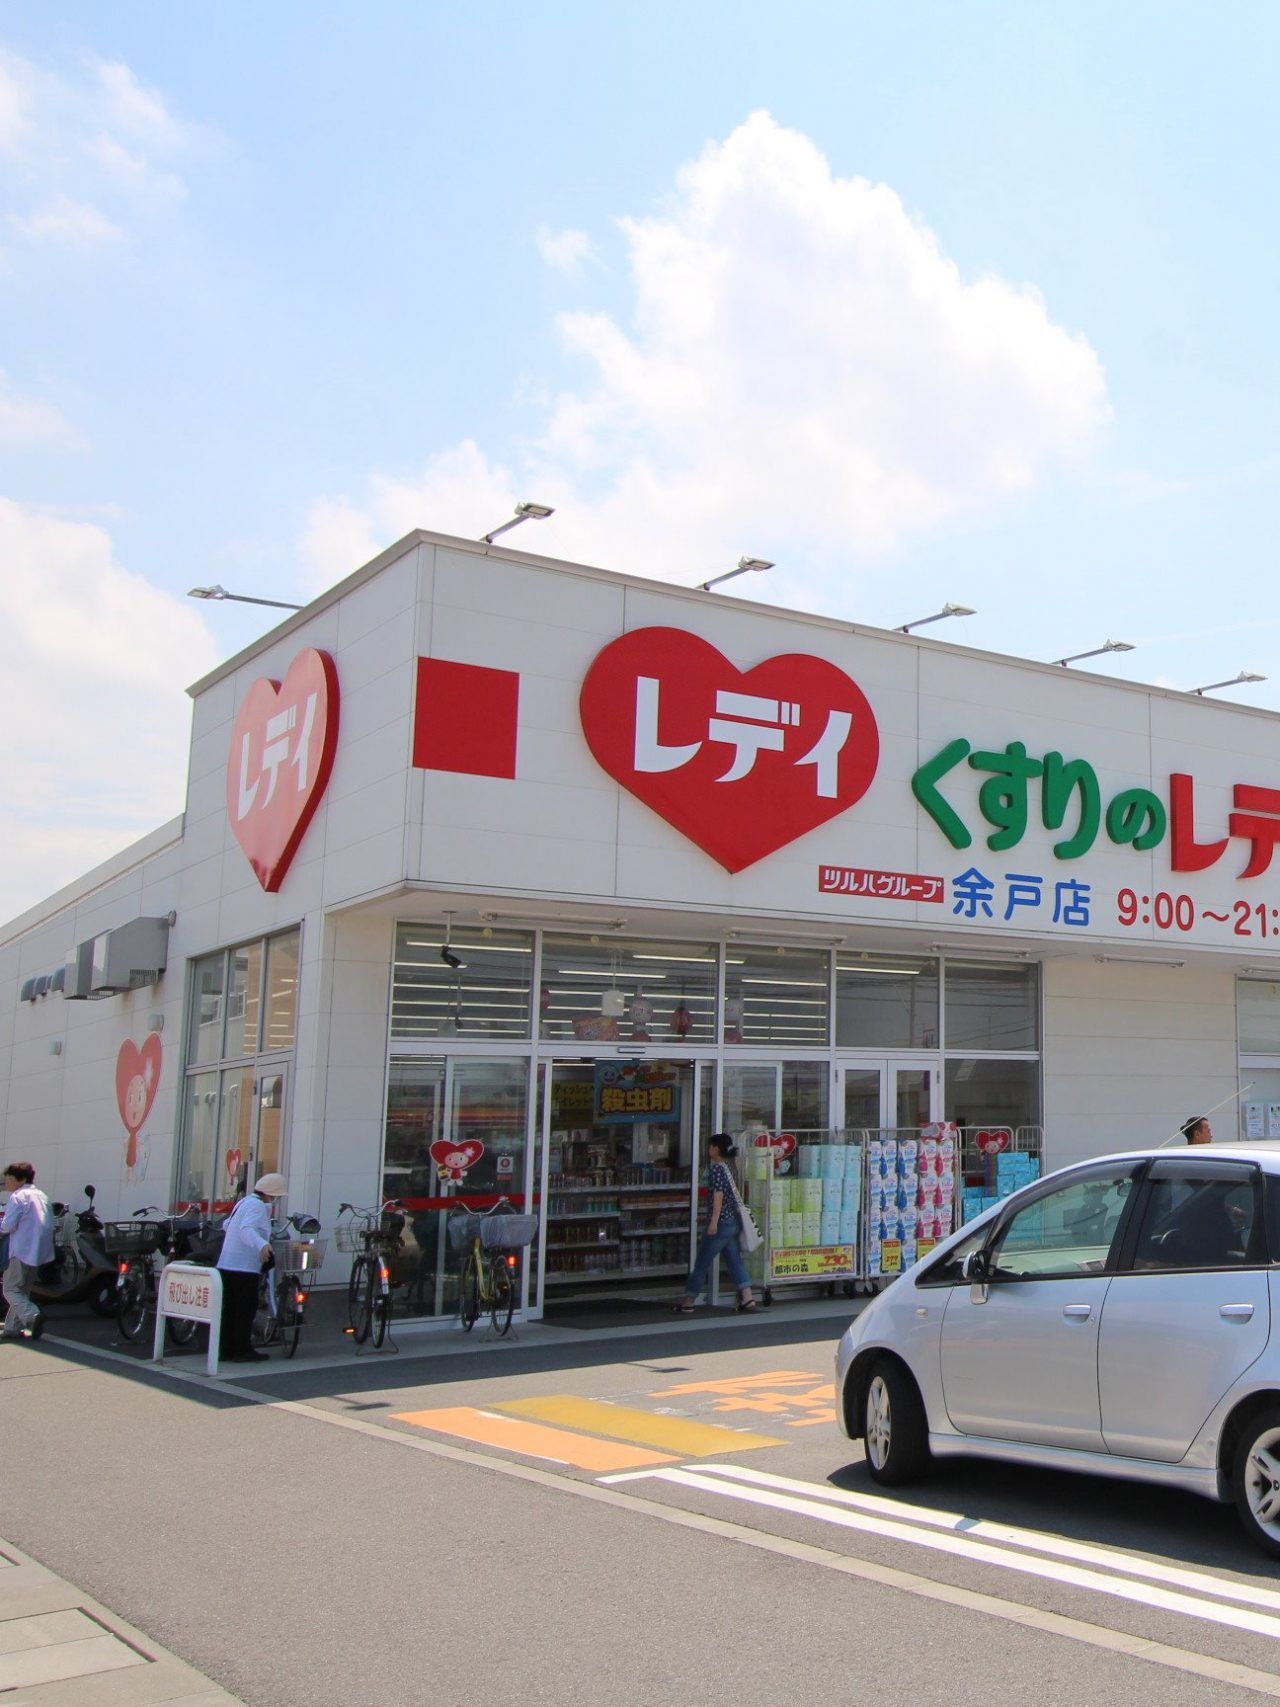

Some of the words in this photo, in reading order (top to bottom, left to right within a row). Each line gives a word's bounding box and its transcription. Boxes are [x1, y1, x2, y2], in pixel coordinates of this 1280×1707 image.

[823, 868, 944, 900] ツルハグループ
[952, 867, 1091, 927] 余戸店
[601, 1085, 673, 1113] 殺虫剤
